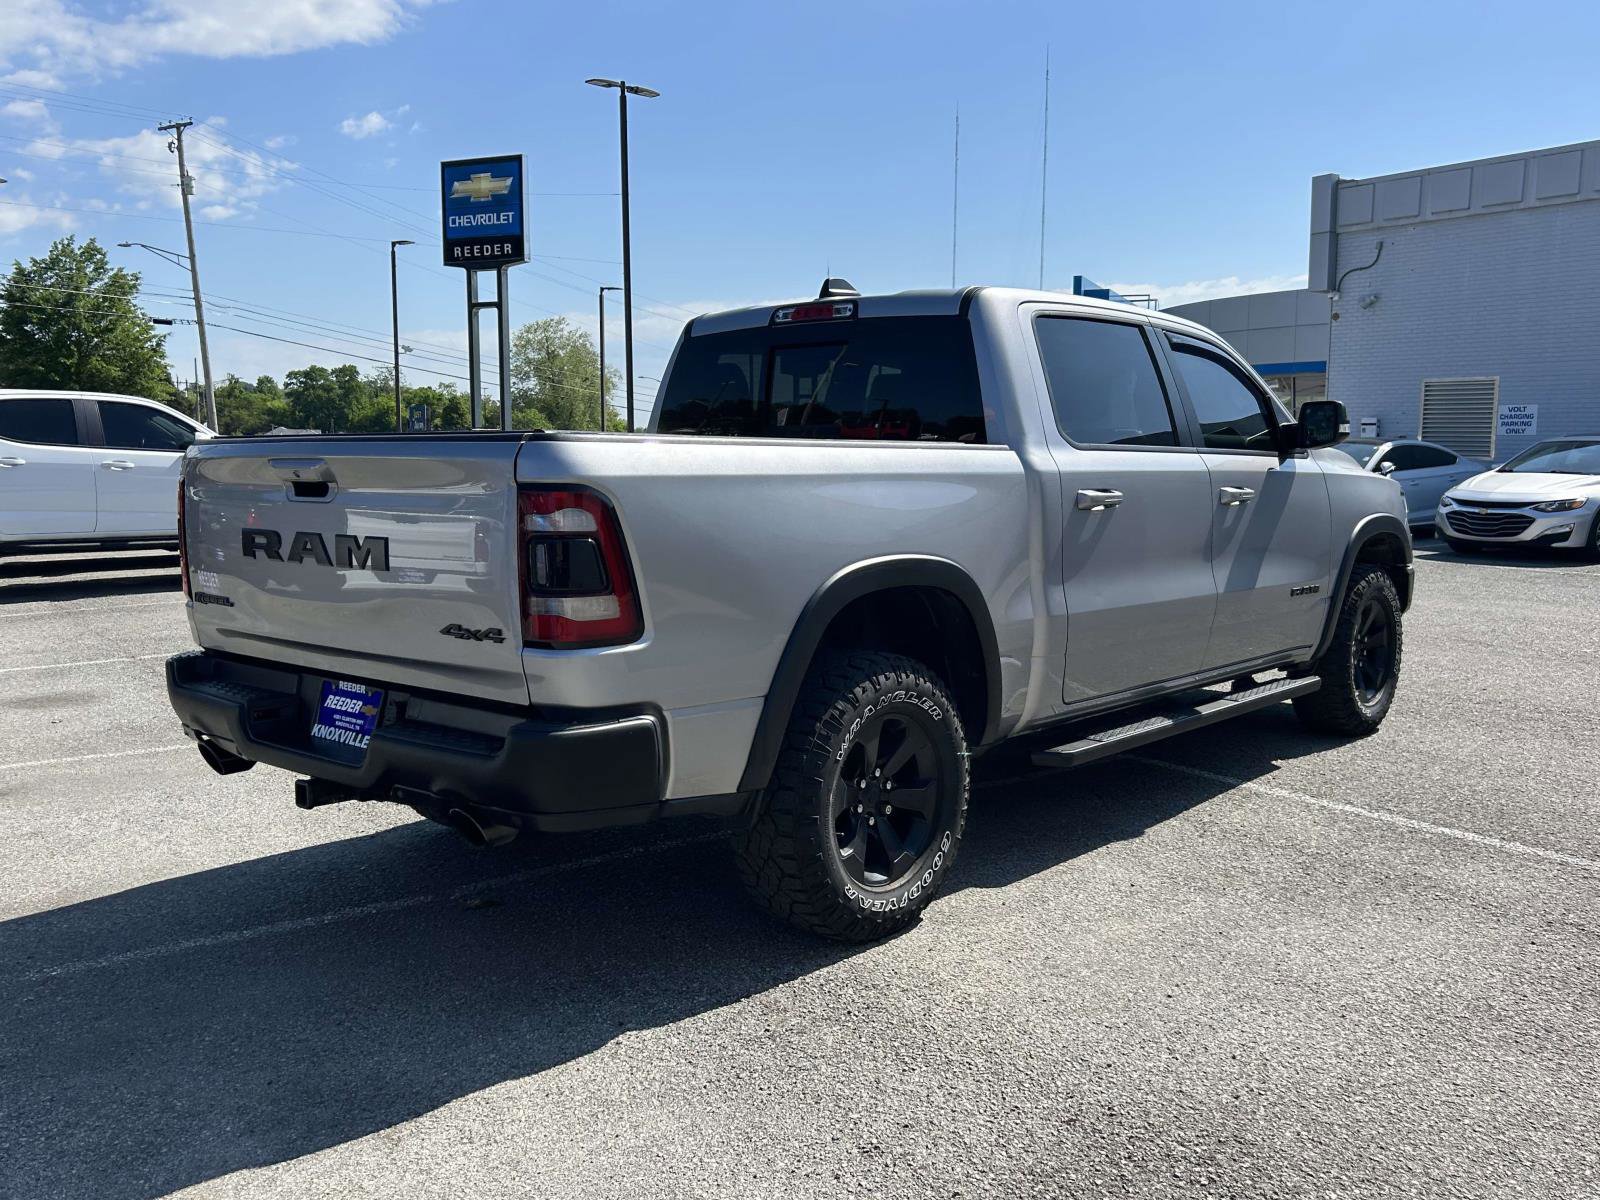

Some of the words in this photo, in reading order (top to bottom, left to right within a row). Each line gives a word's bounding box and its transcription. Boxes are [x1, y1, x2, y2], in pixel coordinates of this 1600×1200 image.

[449, 212, 514, 228] CHEVROLET
[454, 243, 512, 258] REEDER
[241, 528, 390, 571] RAM
[339, 680, 366, 694] REEDER
[324, 694, 363, 714] REEDER
[311, 723, 371, 749] KNOXVILLE
[836, 690, 943, 761] WRANGLER
[844, 831, 952, 912] GOODYEAR
